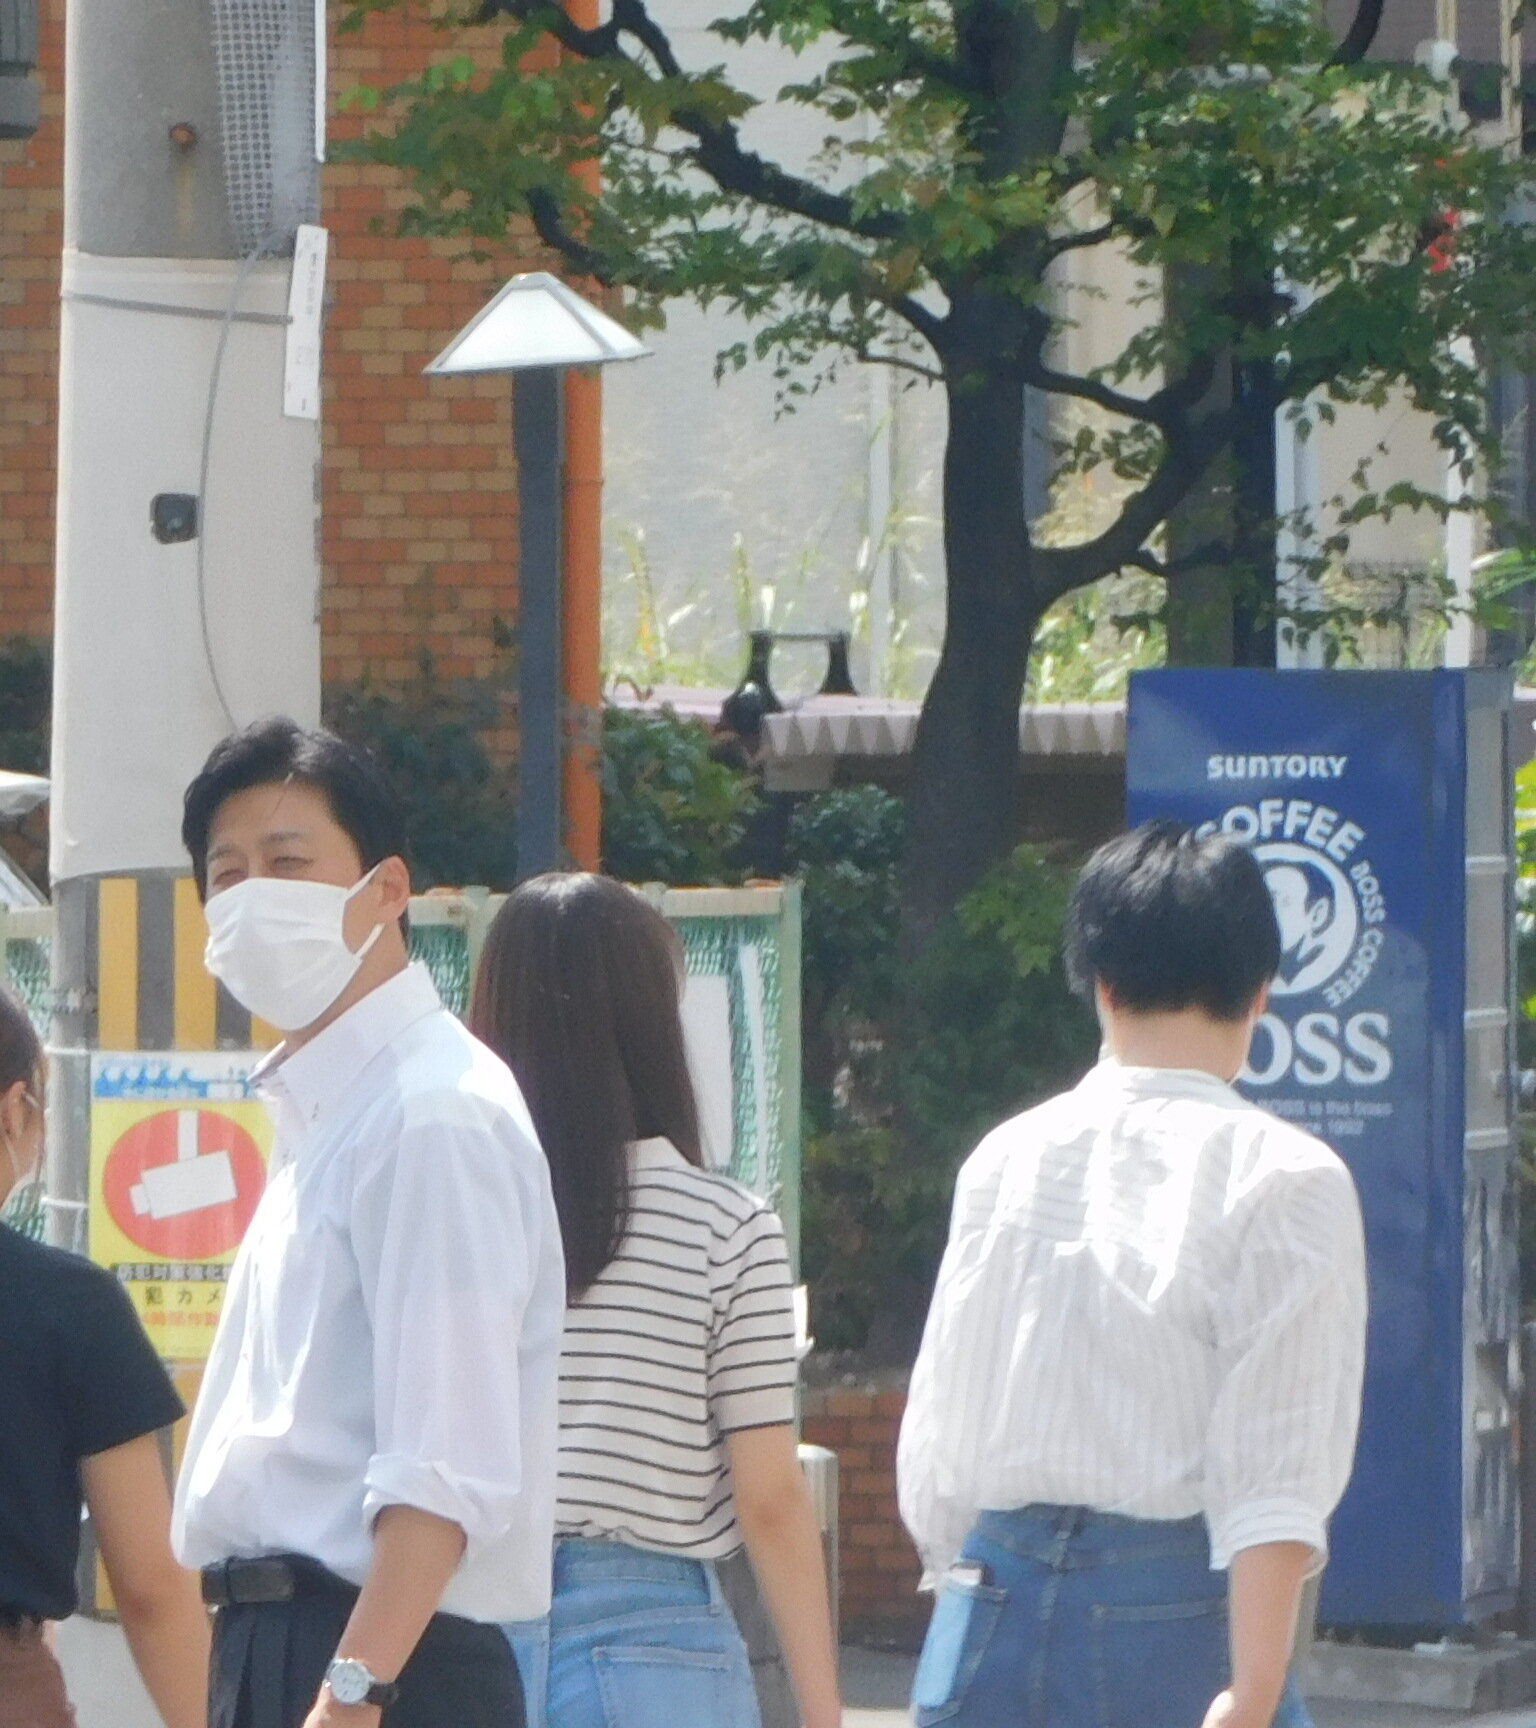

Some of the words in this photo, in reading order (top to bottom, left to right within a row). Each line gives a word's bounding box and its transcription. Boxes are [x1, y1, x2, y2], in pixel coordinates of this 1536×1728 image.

[1207, 754, 1348, 780] SUNTORY
[1350, 860, 1387, 924] BOSS
[1322, 928, 1385, 1008] COFFEE
[1239, 1012, 1393, 1086] OSS
